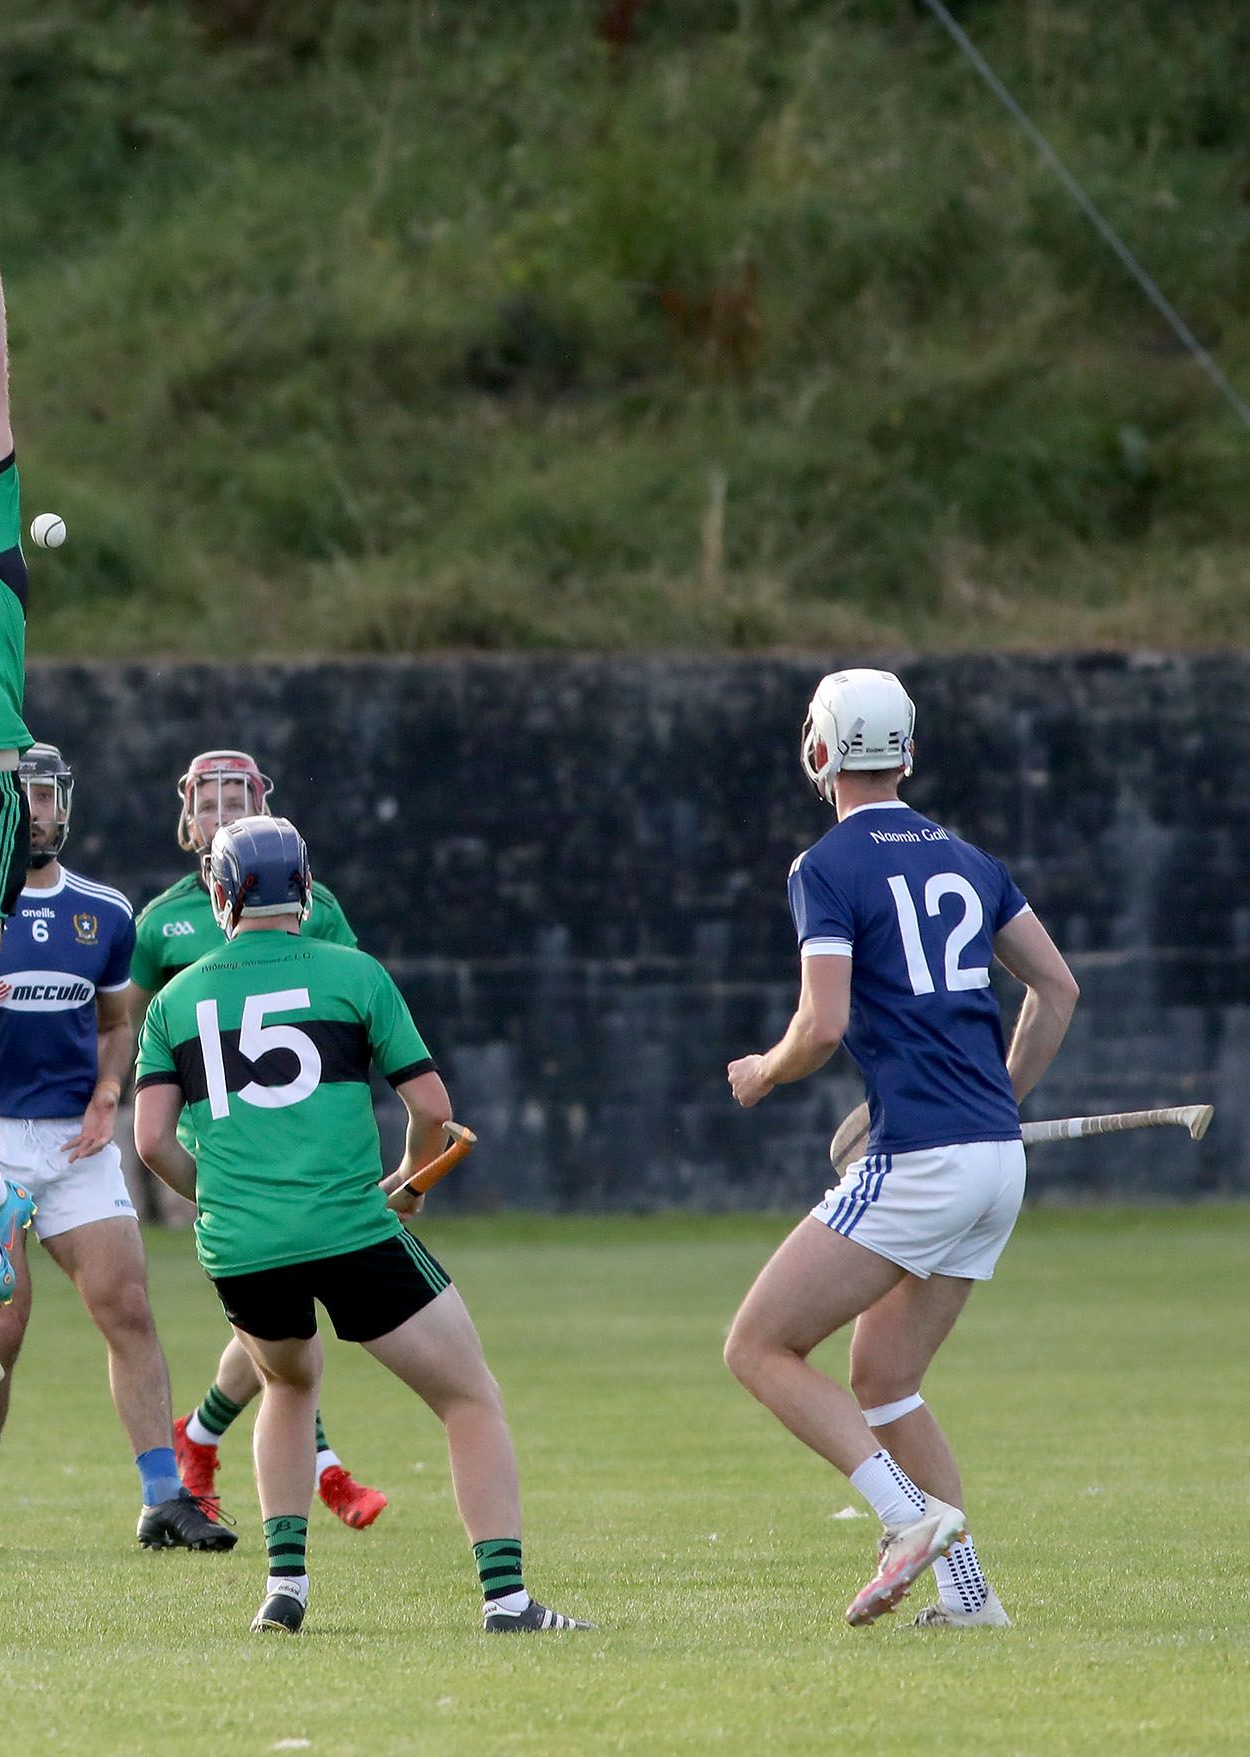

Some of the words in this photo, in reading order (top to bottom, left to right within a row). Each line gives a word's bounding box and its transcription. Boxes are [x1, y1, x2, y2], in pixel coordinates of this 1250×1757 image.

[869, 831, 921, 844] Naomh
[922, 828, 950, 842] Gall
[21, 907, 56, 919] oneills
[31, 919, 49, 943] 6
[886, 872, 991, 997] 12
[195, 987, 323, 1121] 15
